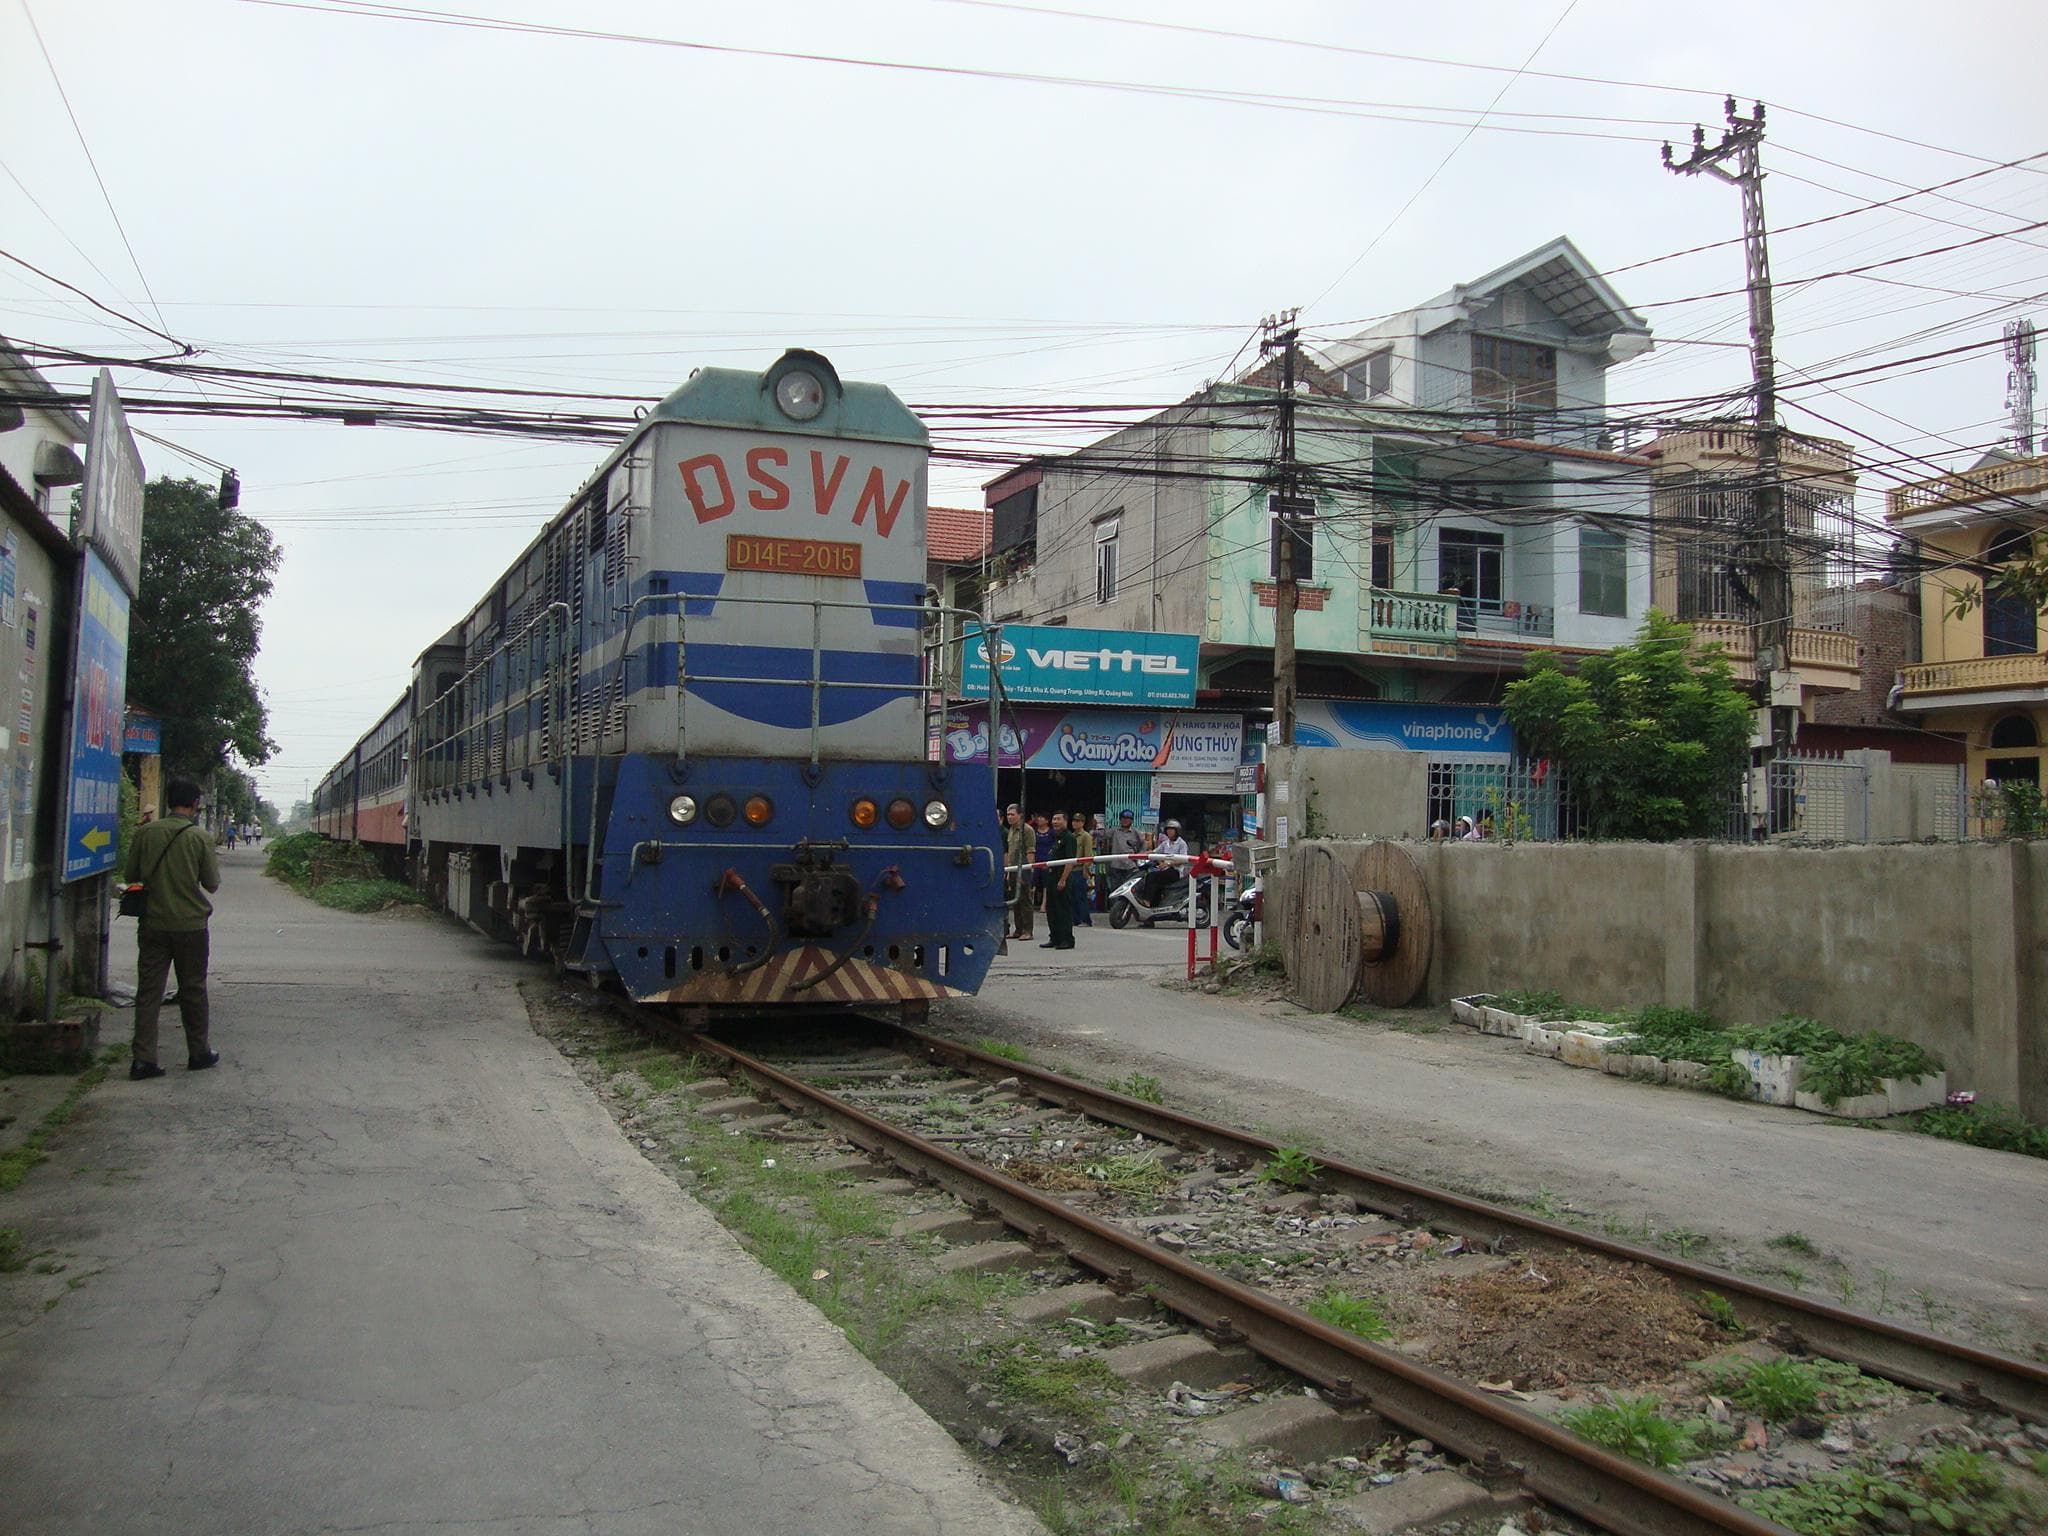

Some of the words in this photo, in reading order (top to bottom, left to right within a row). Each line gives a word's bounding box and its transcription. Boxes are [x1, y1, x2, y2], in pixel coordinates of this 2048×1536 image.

[736, 540, 853, 571] D14E-2015
[1026, 648, 1190, 675] VIETTEL
[1204, 732, 1238, 752] THỦY
[1402, 721, 1482, 741] vinaphone
[1059, 731, 1158, 765] MamyPoko
